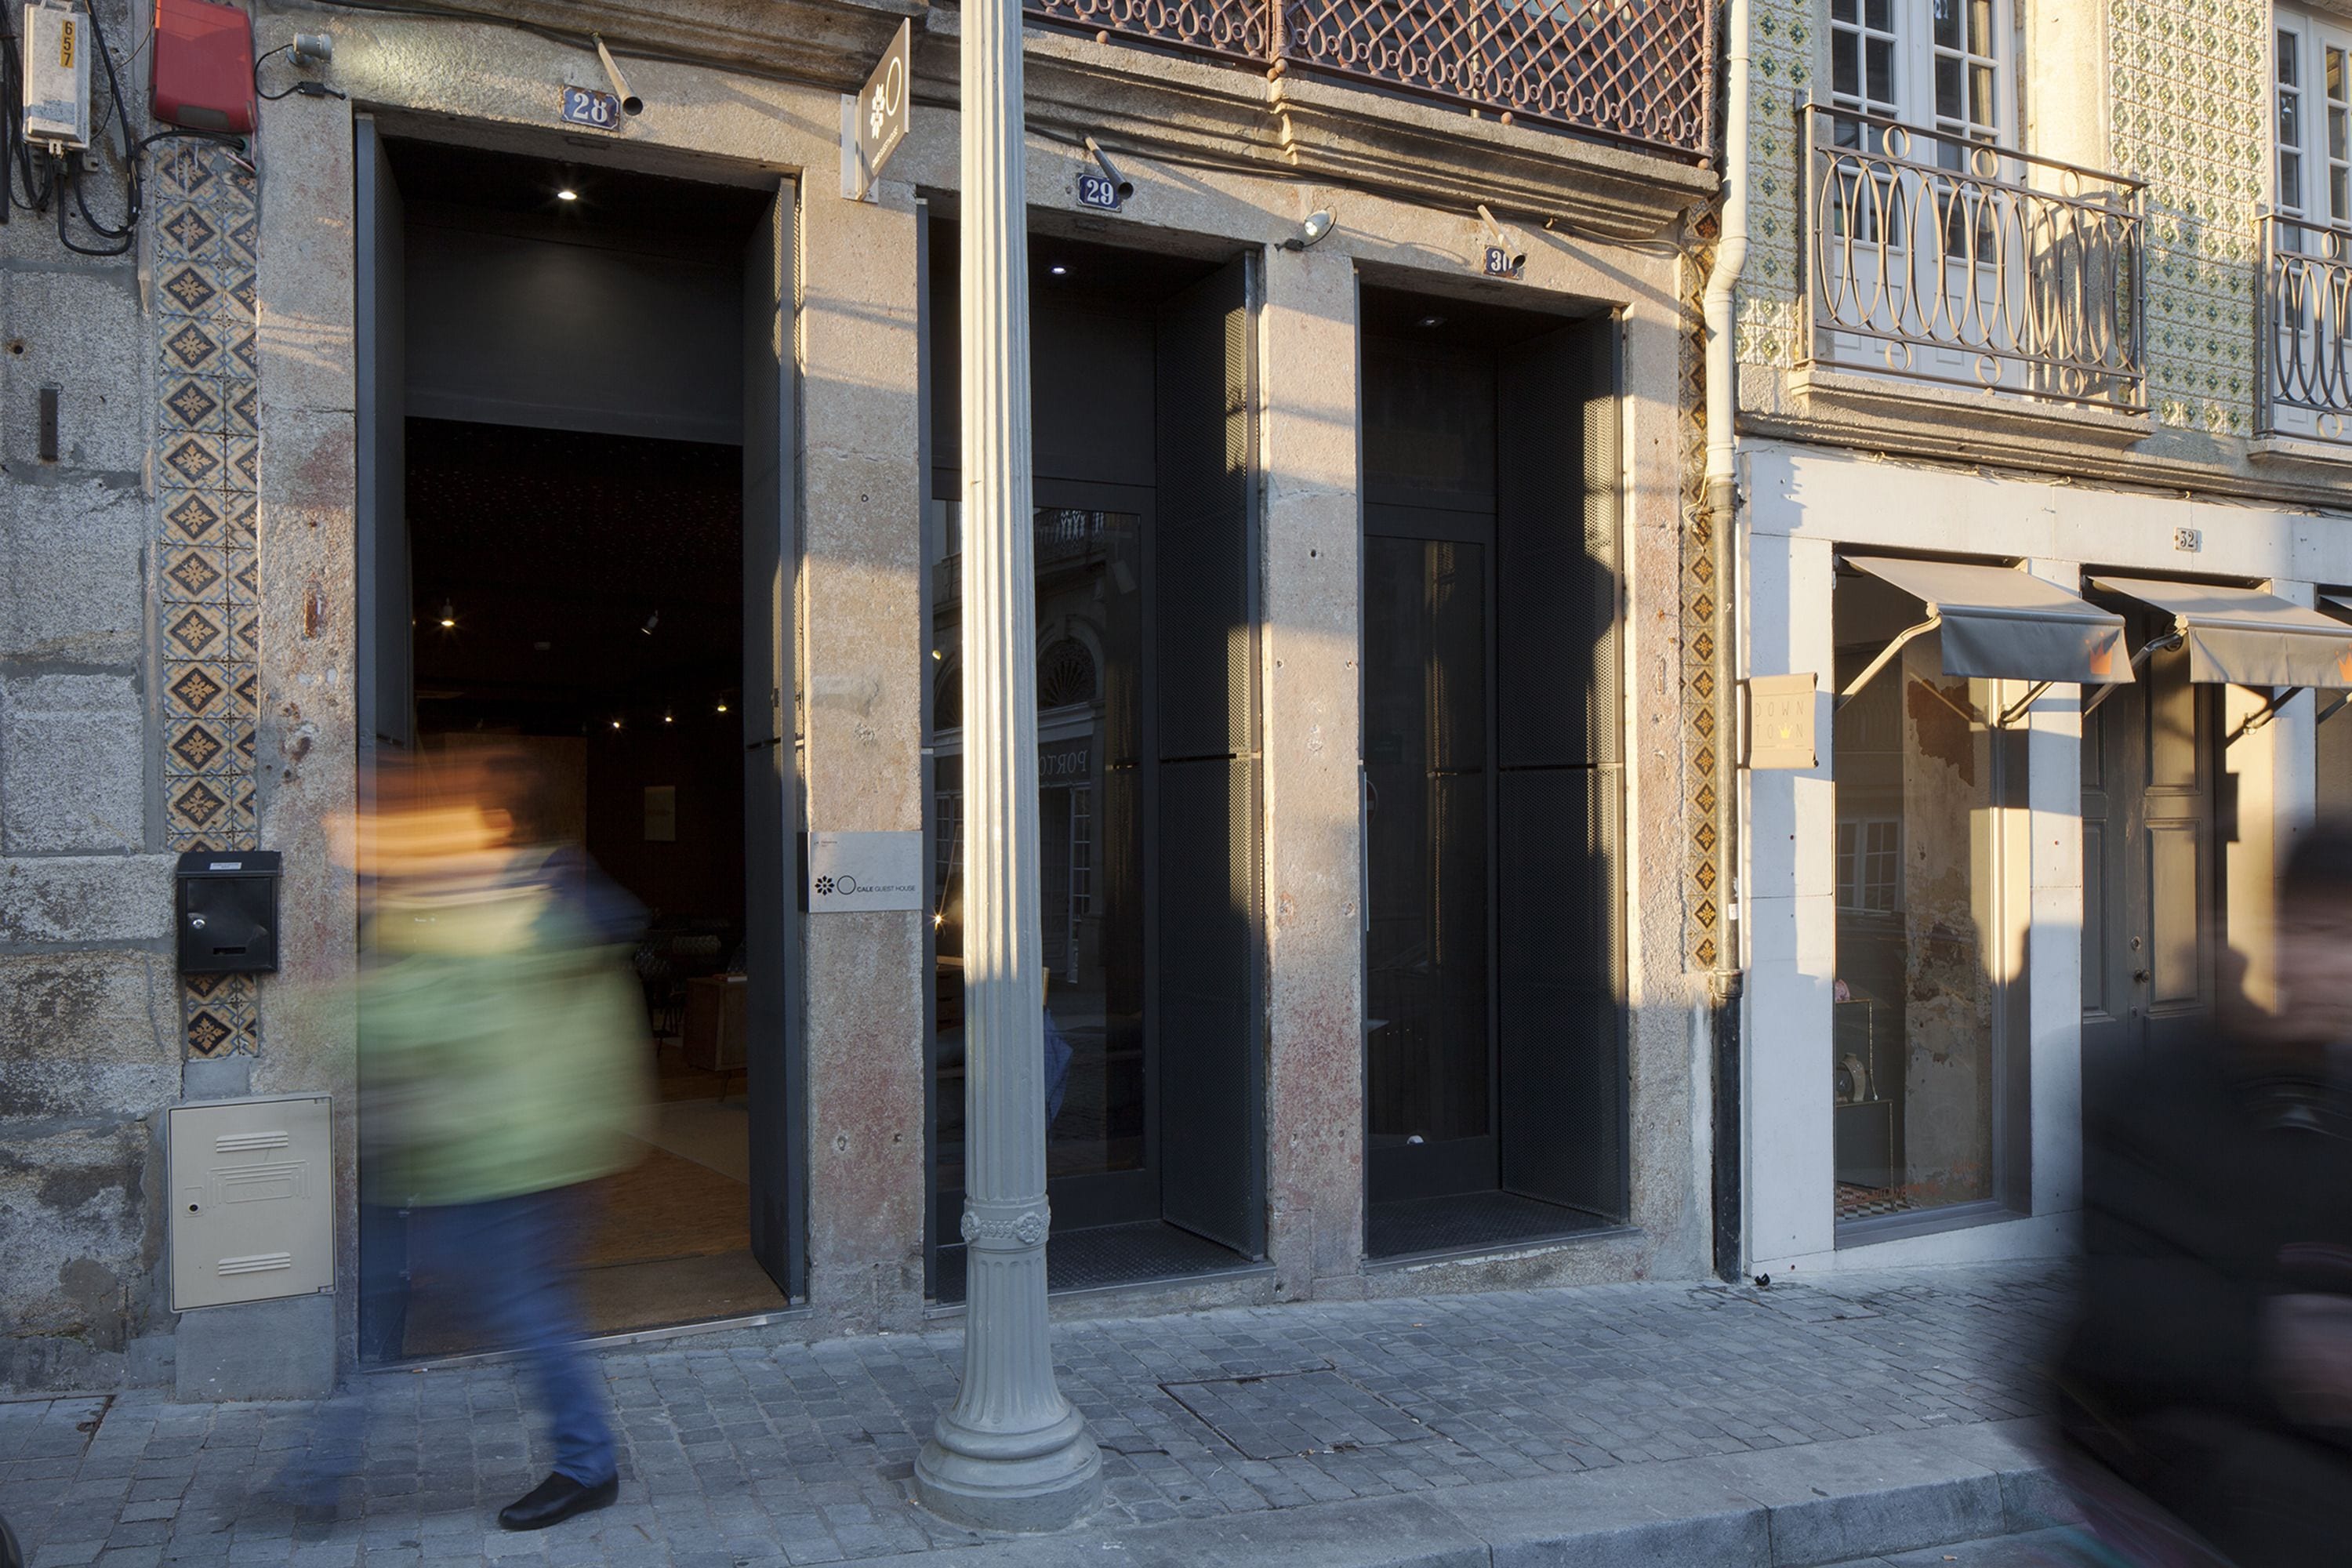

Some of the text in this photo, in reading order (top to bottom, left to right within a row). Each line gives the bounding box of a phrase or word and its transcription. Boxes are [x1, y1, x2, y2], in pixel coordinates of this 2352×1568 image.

[64, 20, 73, 66] 657
[573, 93, 608, 123] 28
[1087, 179, 1114, 205] 29
[2180, 530, 2194, 548] 32
[1755, 701, 1804, 717] DOWN
